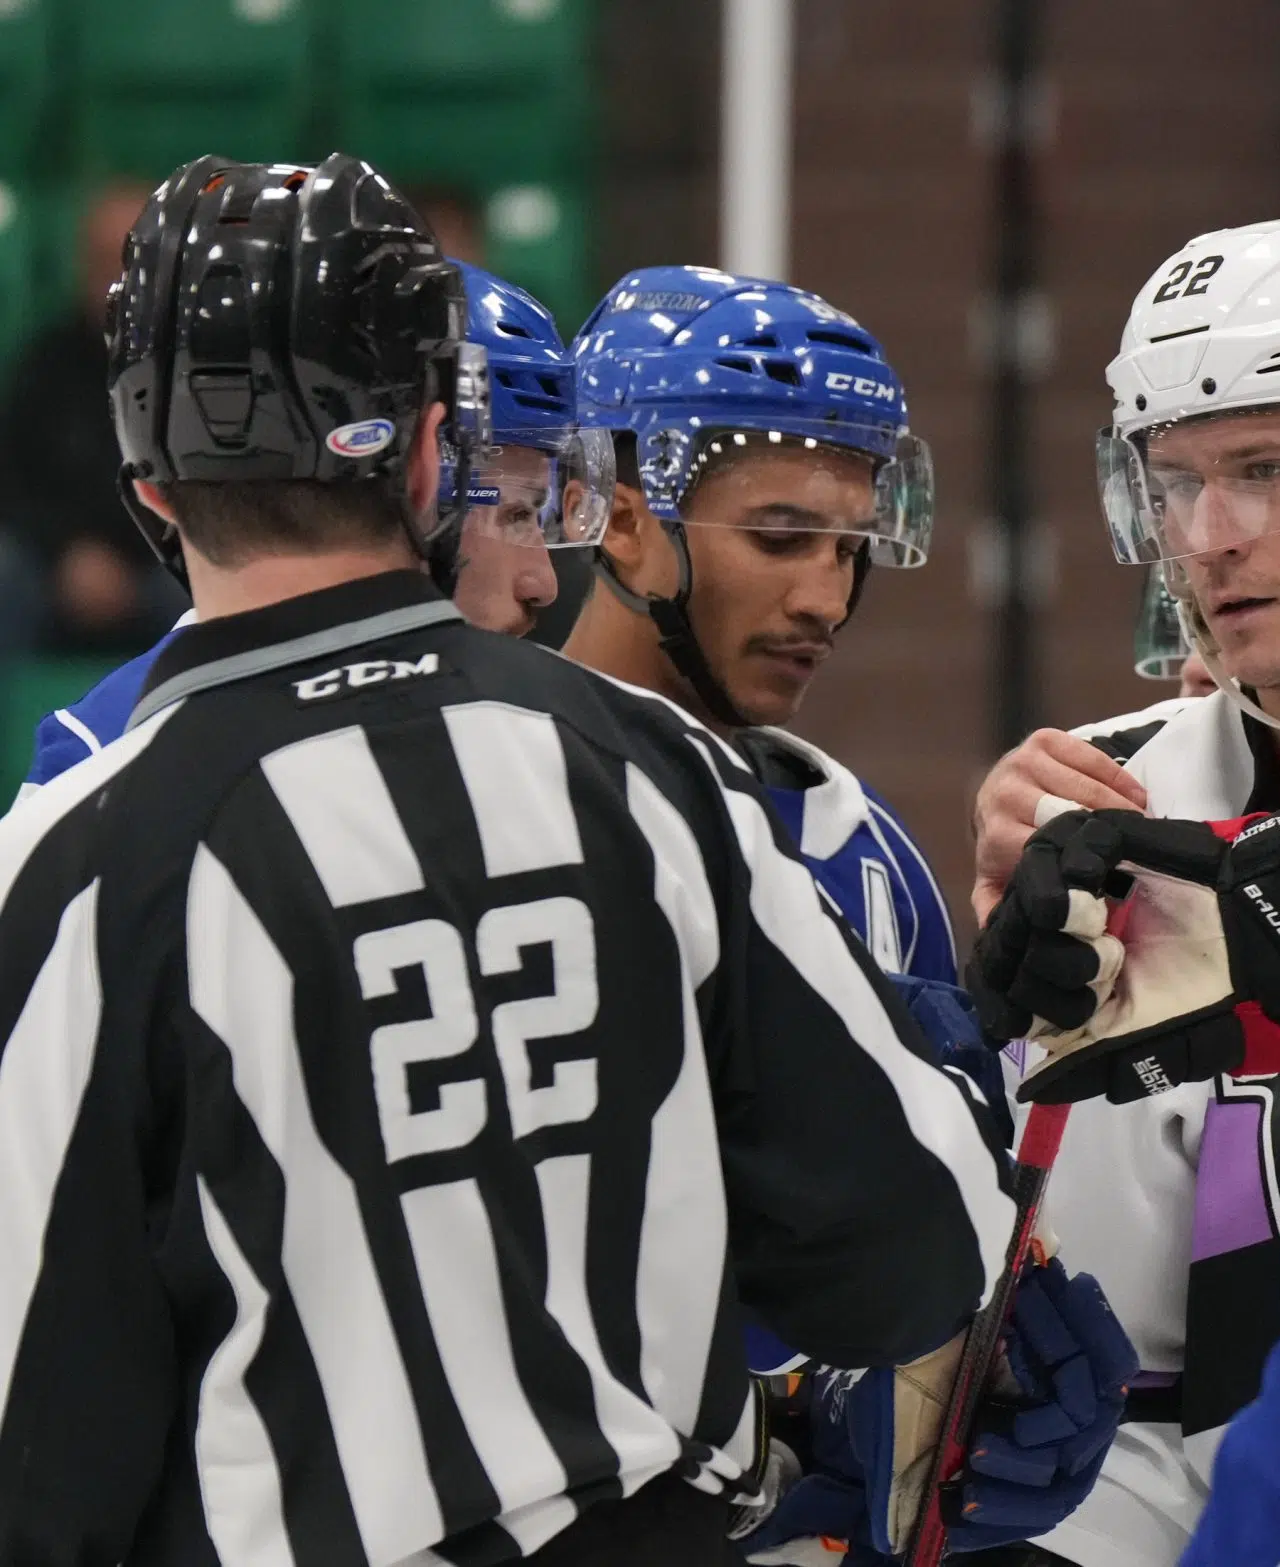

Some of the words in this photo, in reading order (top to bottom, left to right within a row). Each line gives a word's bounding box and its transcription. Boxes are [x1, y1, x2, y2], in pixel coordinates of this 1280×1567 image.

[1152, 255, 1224, 304] 22
[825, 372, 895, 402] CCM
[291, 653, 439, 700] CCM
[353, 896, 600, 1166] 22
